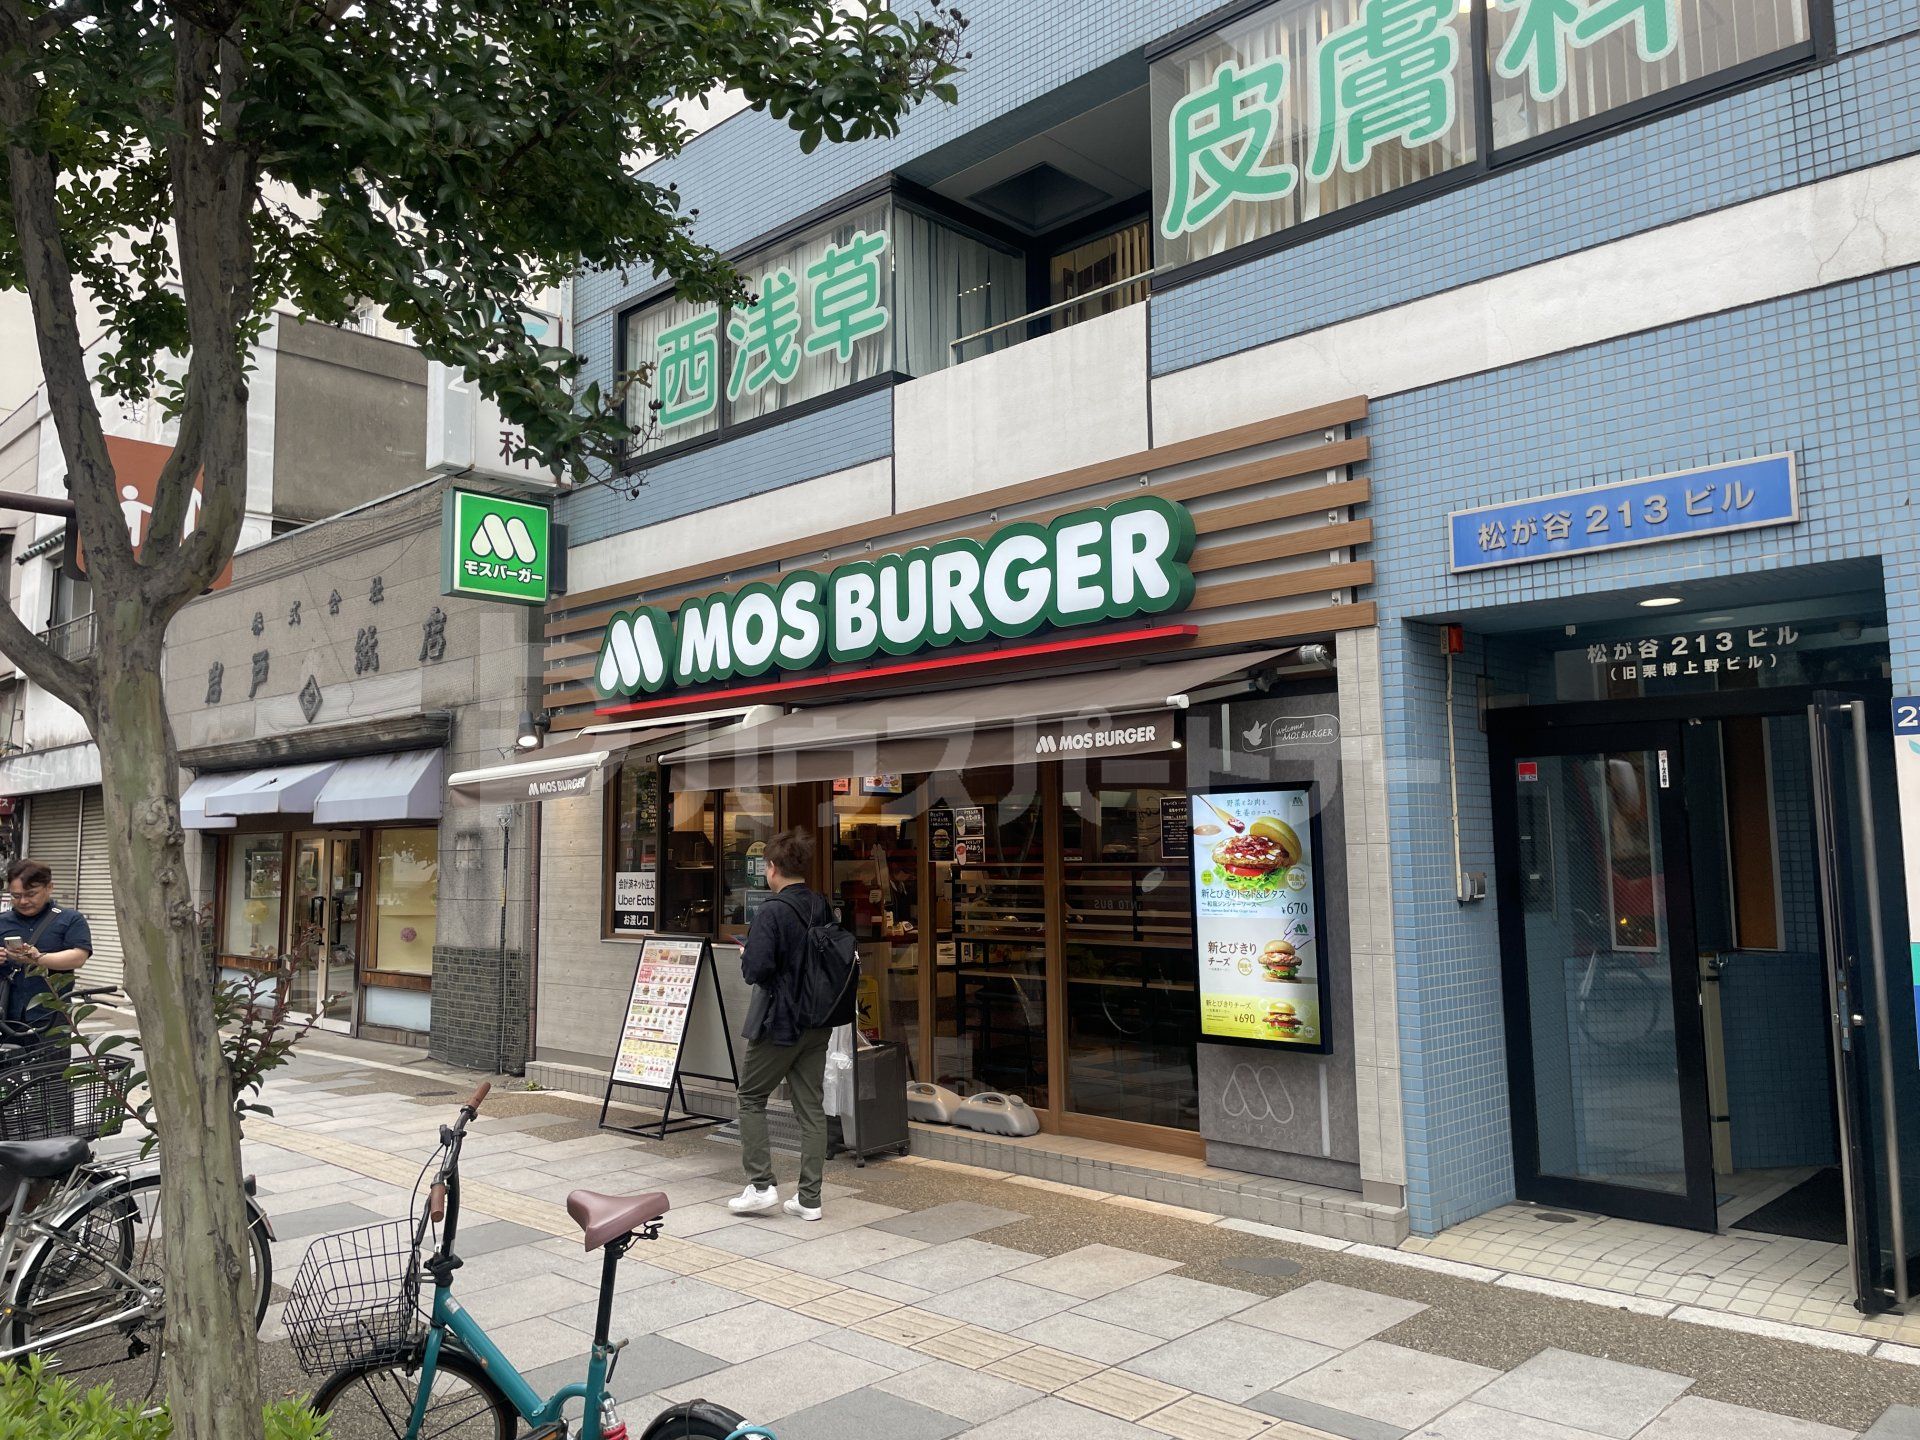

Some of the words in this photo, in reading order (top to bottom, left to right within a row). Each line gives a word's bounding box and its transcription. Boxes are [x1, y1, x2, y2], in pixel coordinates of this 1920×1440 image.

[657, 230, 889, 428] 西浅草
[1478, 510, 1572, 551] 松が谷
[1585, 494, 1669, 533] 213
[1684, 480, 1755, 517] ビル
[464, 560, 543, 583] モスバーガー
[680, 577, 823, 676] MOS
[835, 509, 1169, 649] BURGER
[1587, 639, 1659, 664] 松が谷
[1671, 631, 1733, 656] 213
[1747, 625, 1799, 647] ビル
[1059, 731, 1094, 751] MOS
[1095, 725, 1156, 748] BURGER
[1301, 728, 1334, 738] BURGER
[539, 780, 556, 793] MOS
[557, 776, 586, 792] BURGER
[617, 894, 636, 906] Uber
[637, 893, 655, 906] Eats
[623, 914, 649, 926] お渡し口
[1208, 940, 1257, 955] 新とびきり
[1208, 957, 1230, 966] チーズ
[1234, 1013, 1256, 1024] ¥690
